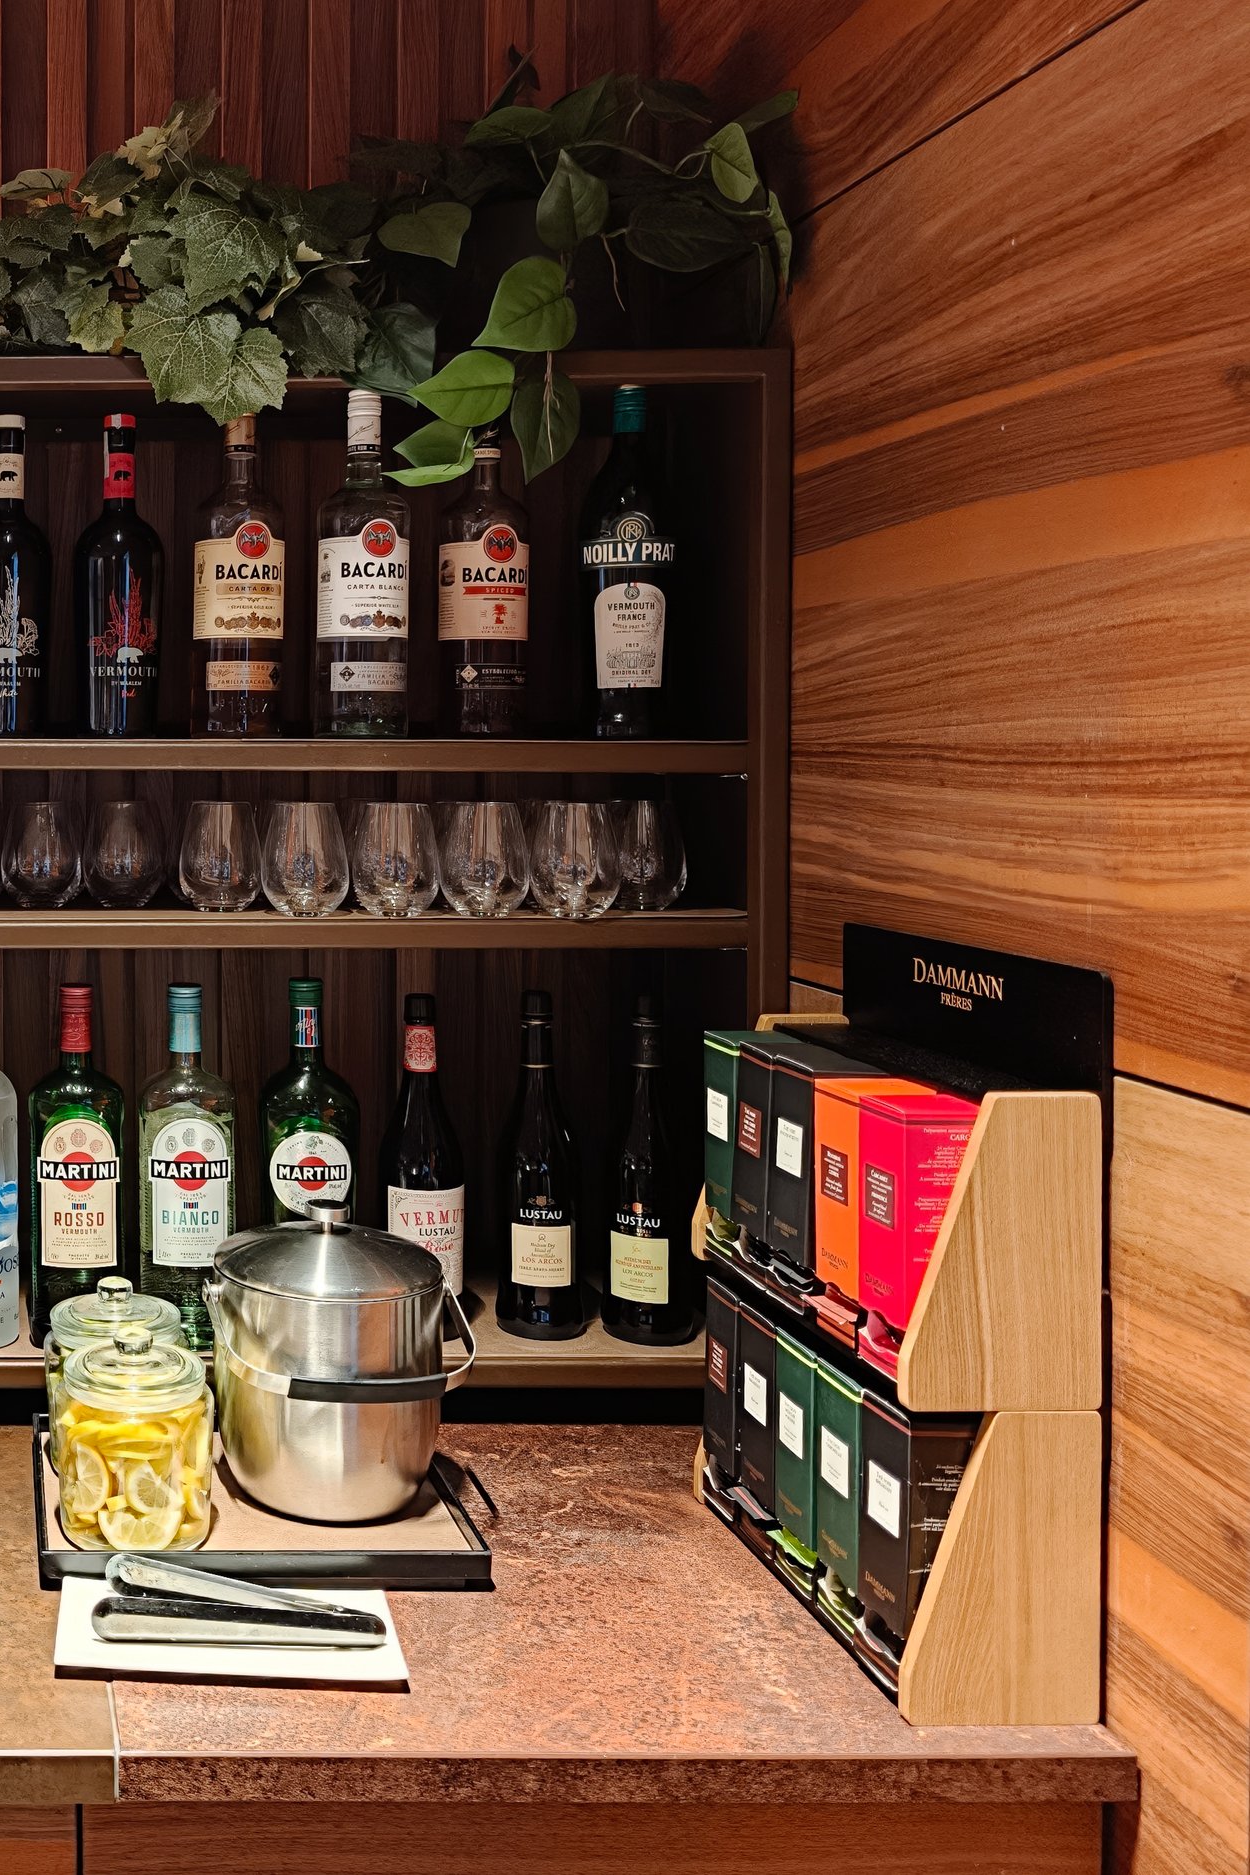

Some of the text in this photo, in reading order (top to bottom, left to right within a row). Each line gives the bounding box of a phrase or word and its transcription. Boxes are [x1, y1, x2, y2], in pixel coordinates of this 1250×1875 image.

[583, 542, 675, 565] NOILLY PRAT
[607, 602, 655, 611] VERMOUTH
[617, 613, 646, 621] FRANCE
[90, 666, 157, 677] VERMOUTH
[912, 957, 1004, 1001] DAMMANN
[940, 991, 973, 1011] FRÈRES
[42, 1162, 115, 1180] MARTINI
[153, 1161, 227, 1179] MARTINI
[278, 1165, 345, 1180] MARTINI
[54, 1212, 104, 1227] ROSSO
[162, 1210, 219, 1226] BIANCO
[519, 1208, 563, 1220] LUSTAU
[616, 1213, 661, 1228] LUSTAU
[419, 1226, 456, 1237] LUSTAU
[538, 1257, 563, 1265] ARCOS
[633, 1270, 654, 1278] ARCOS
